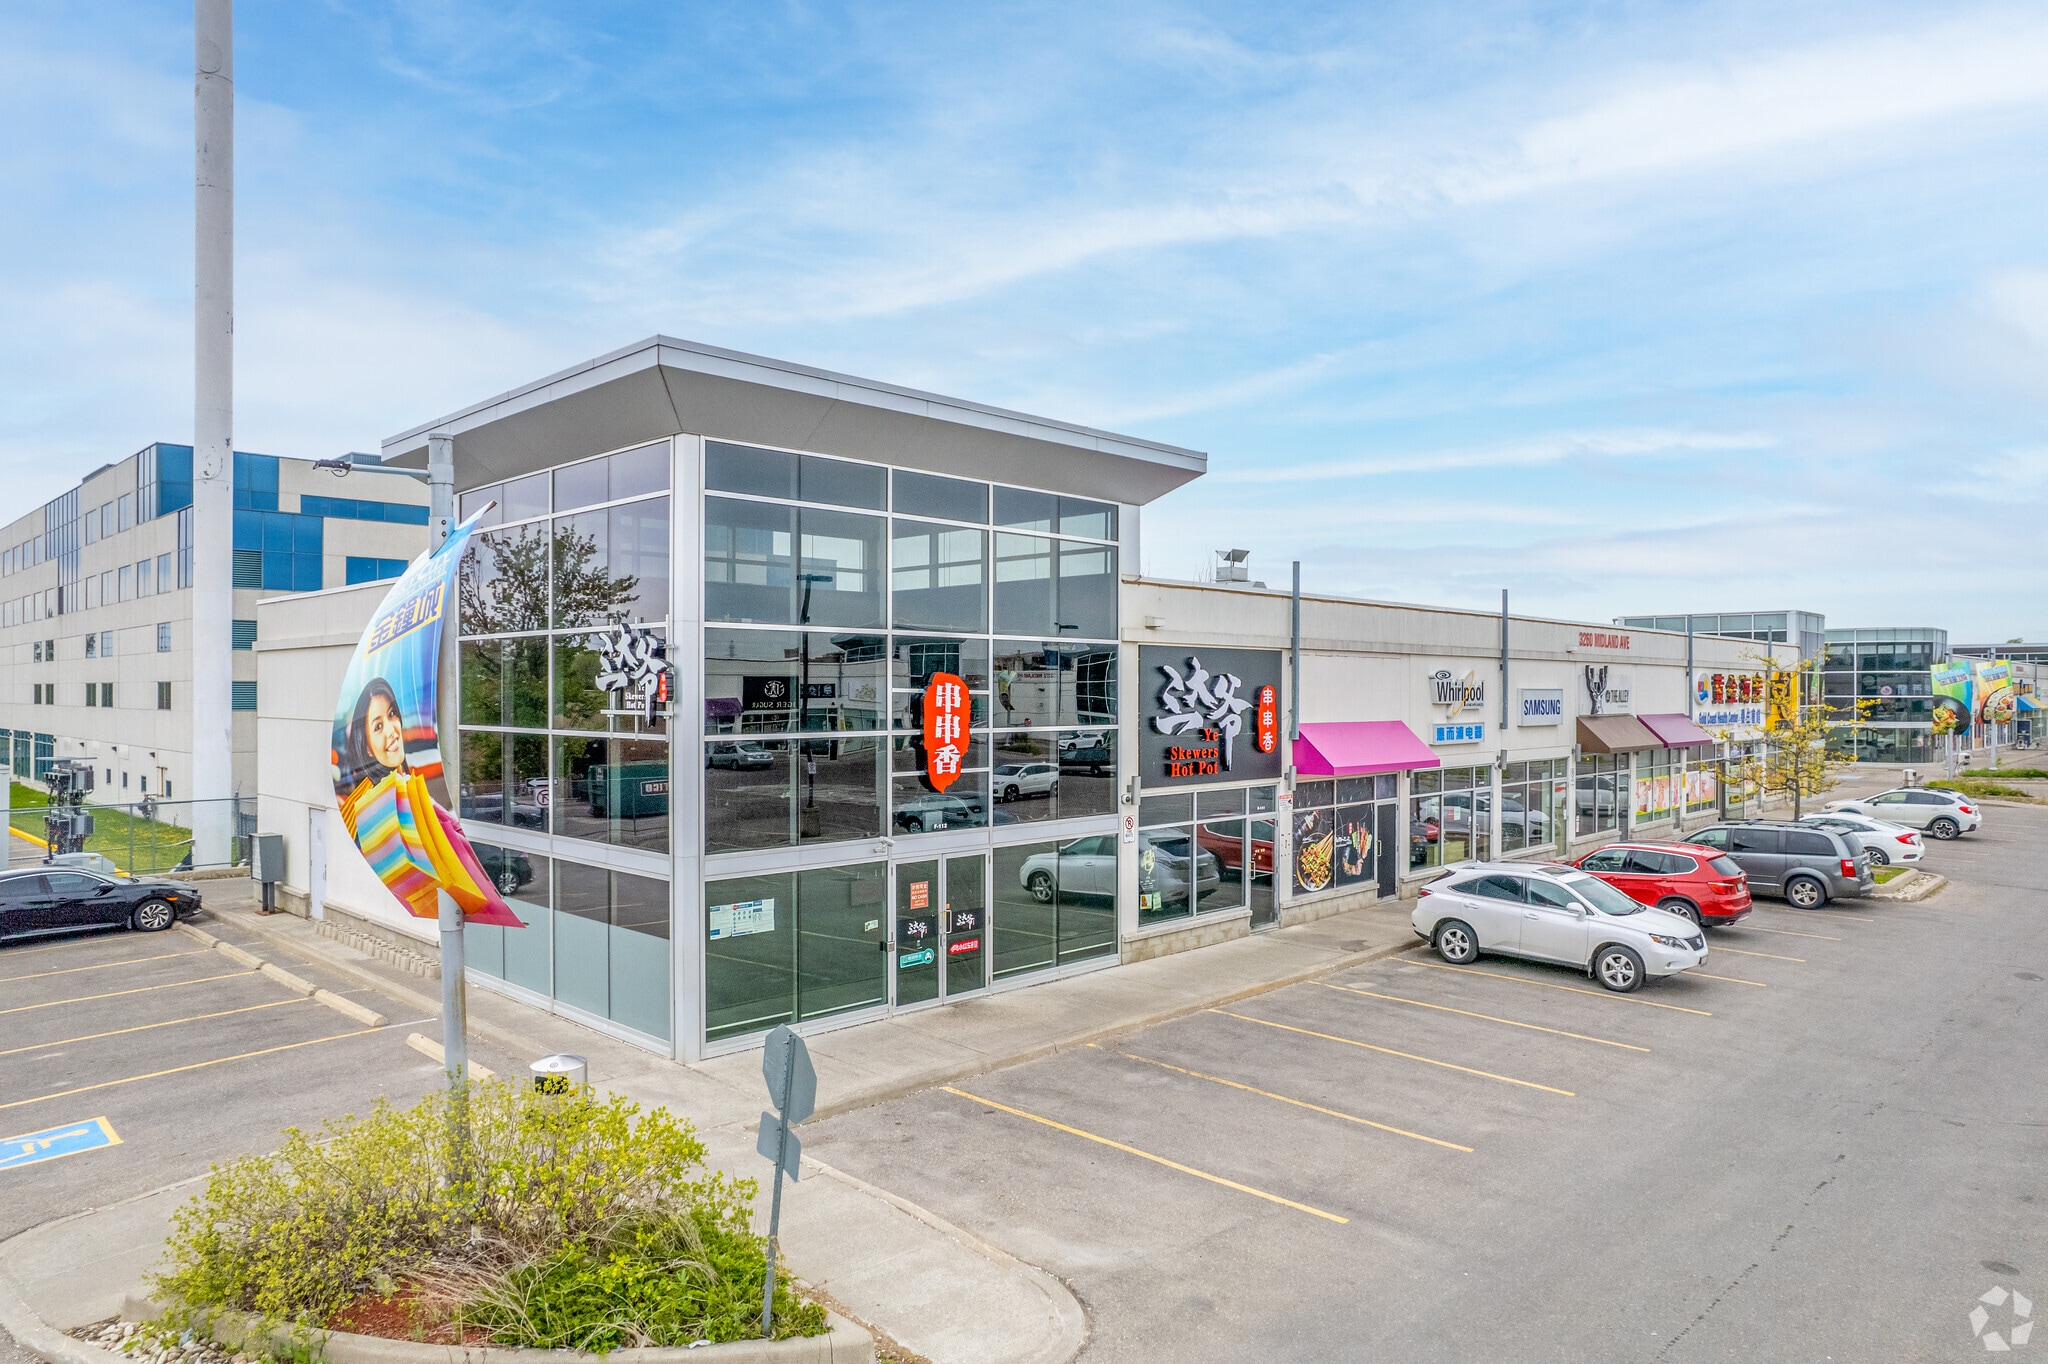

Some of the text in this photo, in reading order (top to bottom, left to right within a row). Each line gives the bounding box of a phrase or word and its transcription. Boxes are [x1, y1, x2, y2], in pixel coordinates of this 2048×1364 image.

[1579, 632, 1630, 650] 3260 MIDLAND AVE
[1437, 681, 1484, 706] Whirlpool
[637, 701, 645, 710] Po
[1524, 699, 1561, 716] SAMSUNG
[1262, 688, 1274, 751] 串串香
[933, 682, 961, 775] 串串香
[1203, 728, 1219, 742] Ye
[1171, 746, 1219, 760] Skewers
[1171, 761, 1219, 778] Hot Pot
